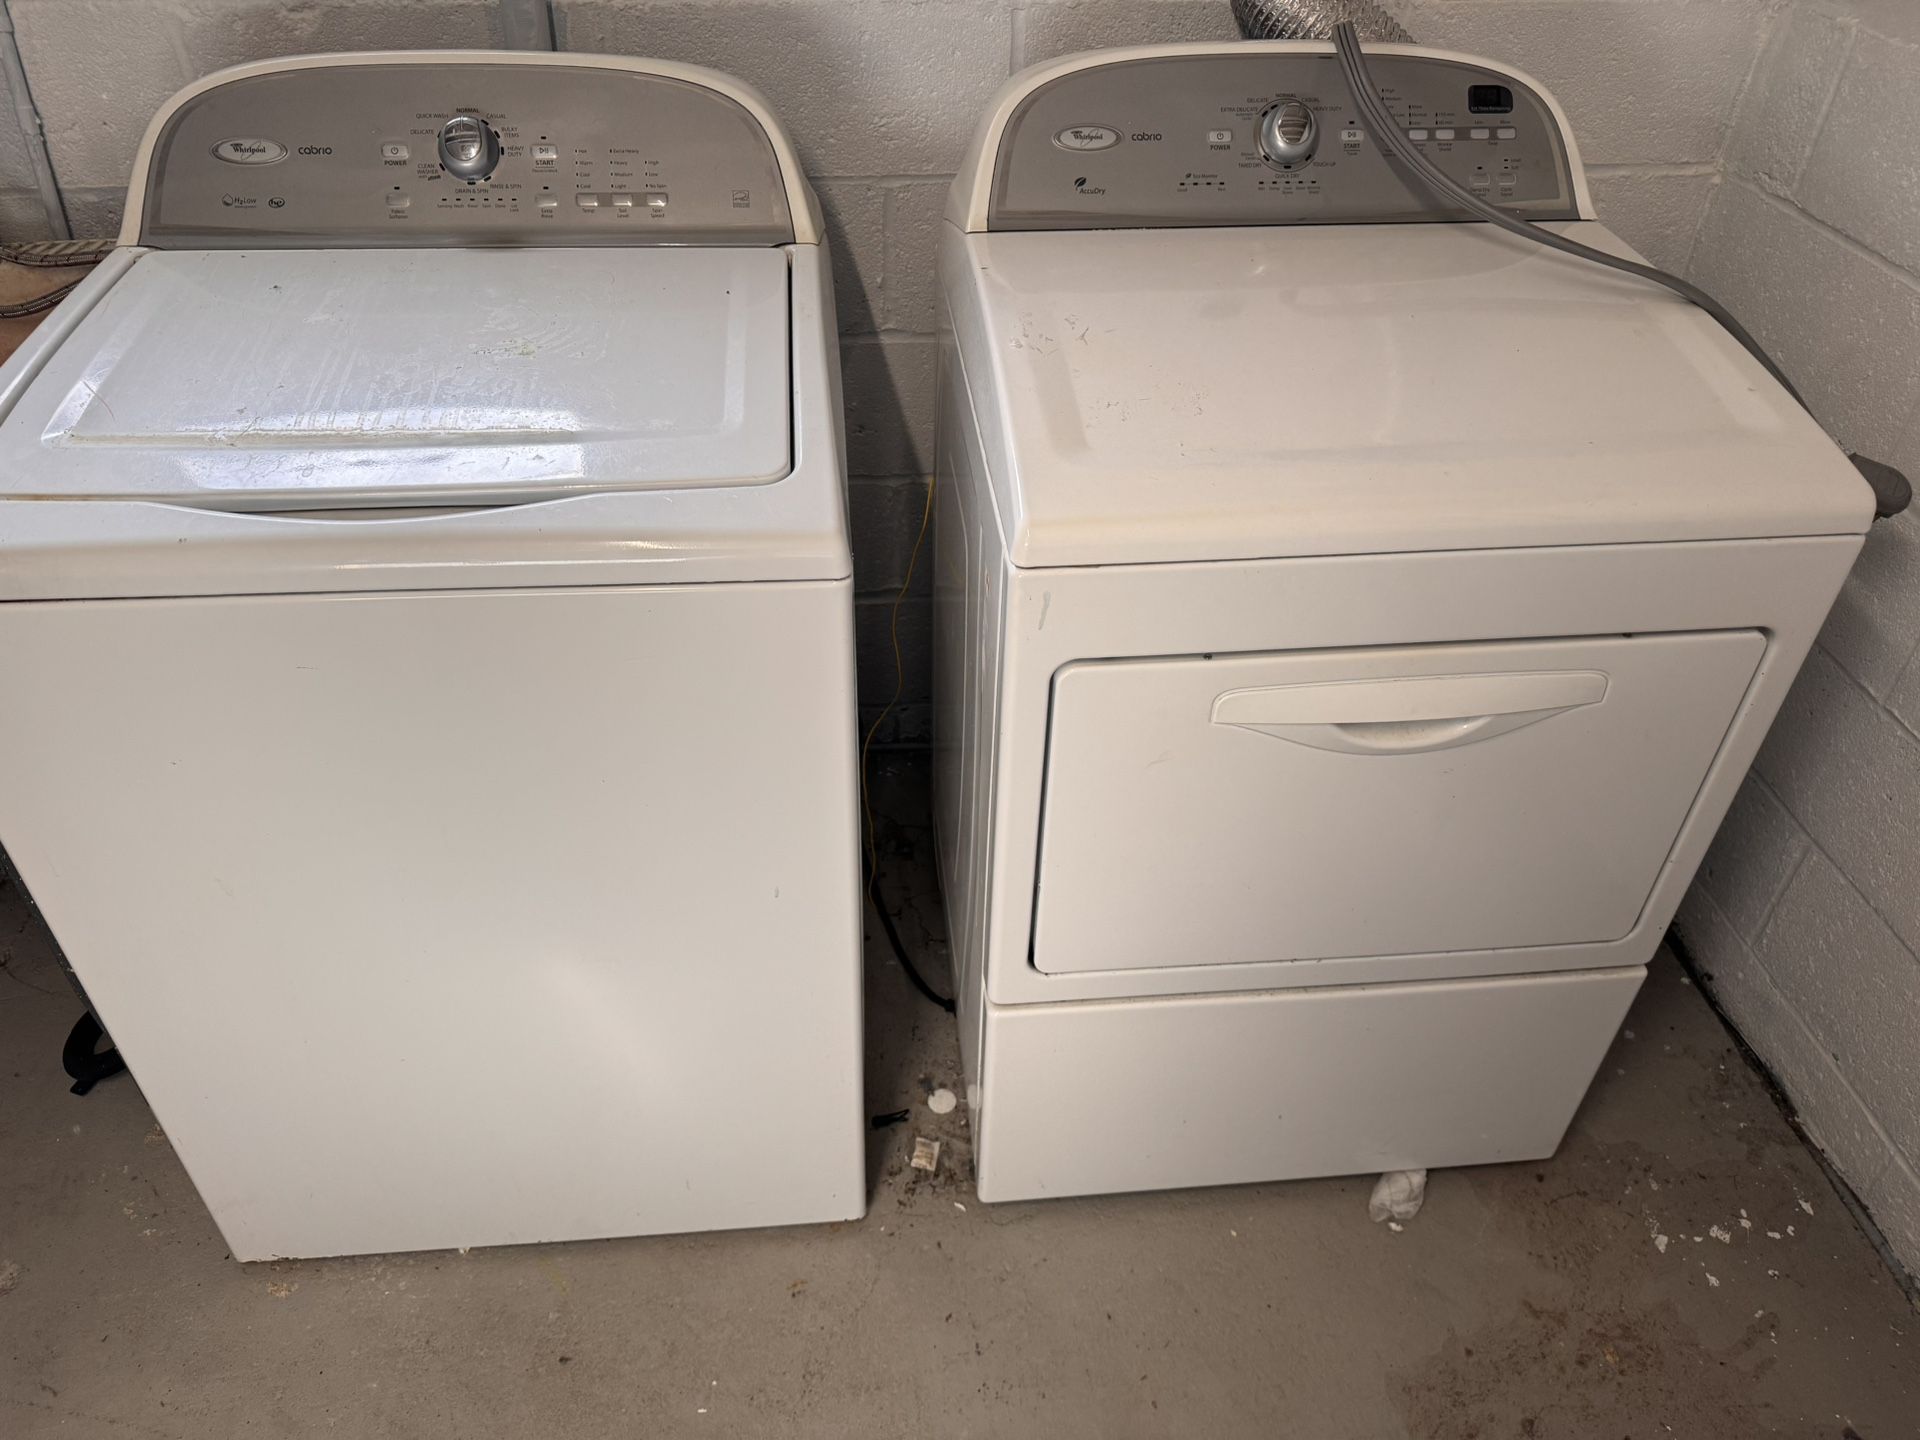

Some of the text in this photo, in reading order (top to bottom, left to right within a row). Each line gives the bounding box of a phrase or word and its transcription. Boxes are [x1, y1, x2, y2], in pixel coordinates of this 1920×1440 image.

[1070, 130, 1103, 142] Whirlpool
[1131, 132, 1162, 142] cabrio
[230, 143, 266, 154] Whirlpool
[298, 145, 332, 155] cabrio
